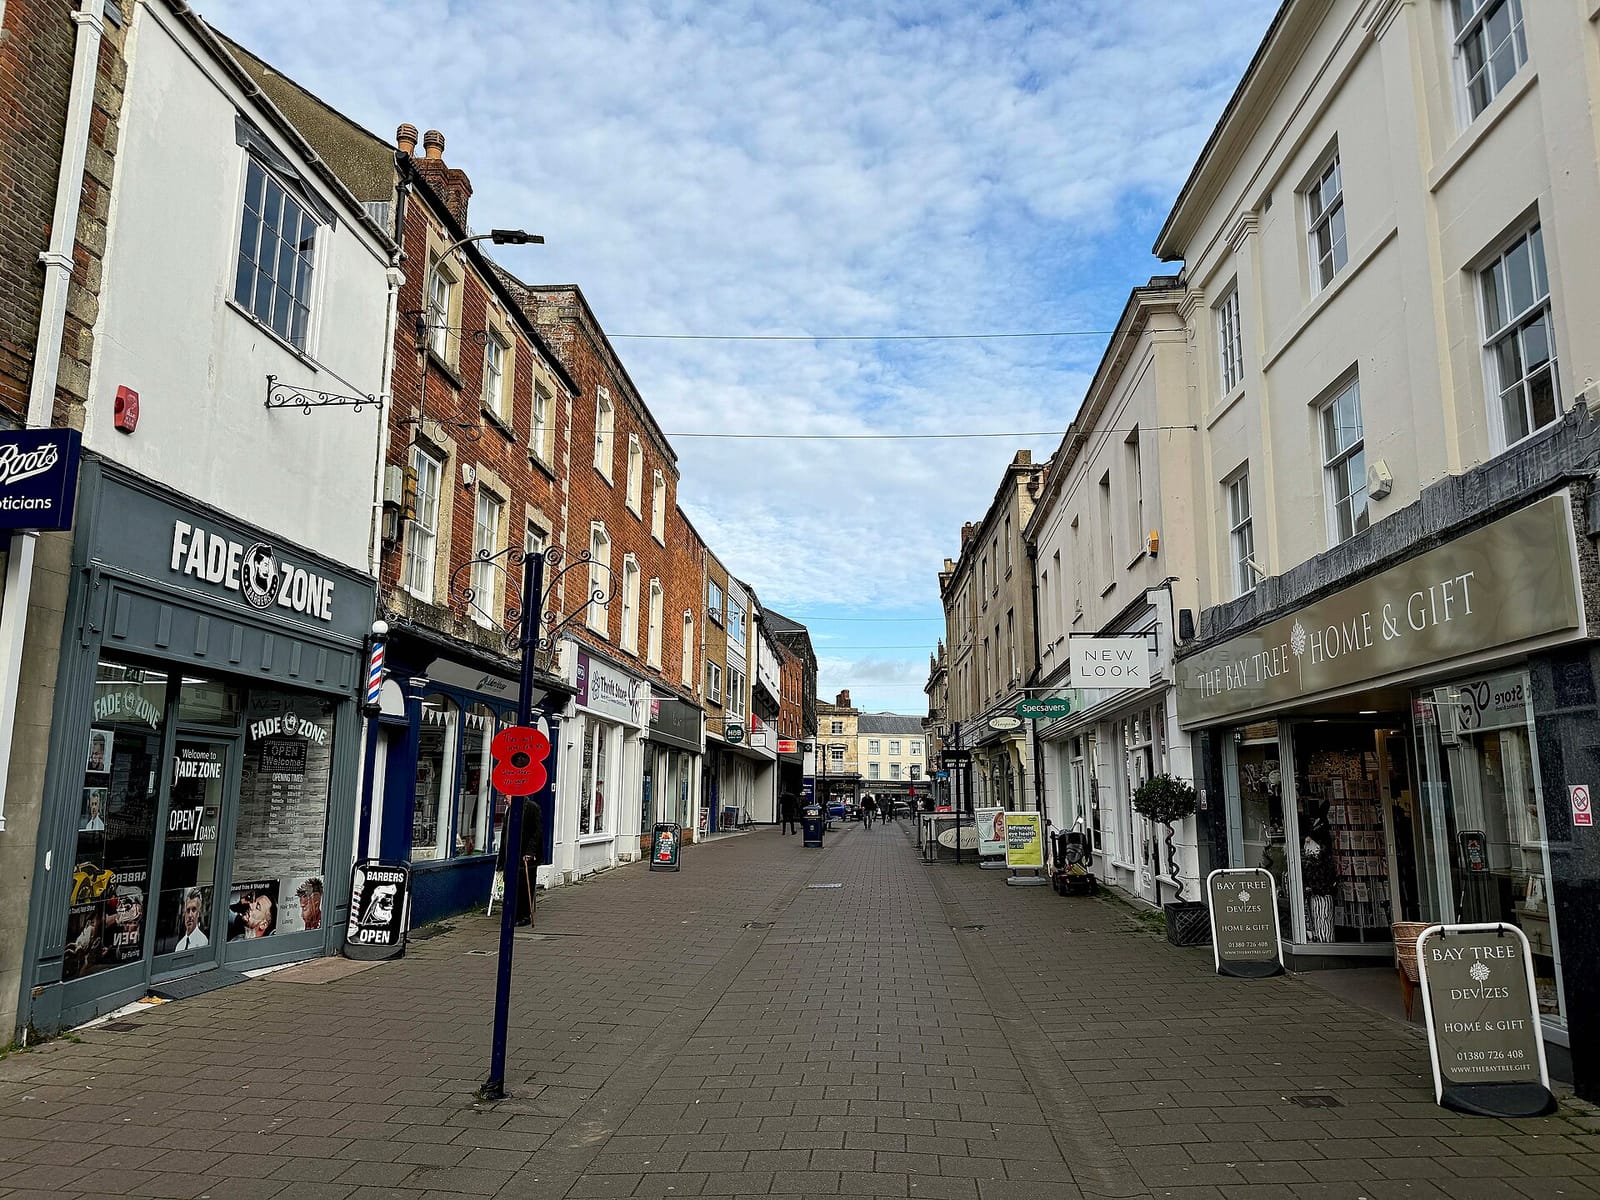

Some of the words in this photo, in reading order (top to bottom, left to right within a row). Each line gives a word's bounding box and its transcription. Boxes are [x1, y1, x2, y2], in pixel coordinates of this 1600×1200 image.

[0, 443, 58, 486] Boots
[171, 519, 244, 591] FADE
[277, 562, 335, 621] ZONE
[1198, 669, 1221, 699] THE
[1225, 658, 1248, 691] BAY
[1252, 643, 1290, 682] TREE
[1309, 611, 1374, 665] HOME
[1382, 603, 1401, 641] &
[1407, 570, 1475, 632] GIFT
[1085, 650, 1133, 661] NEW
[1081, 665, 1139, 677] LOOK
[600, 676, 615, 697] Thrift
[615, 683, 628, 701] Store
[94, 692, 122, 722] FADE
[135, 696, 160, 730] ZONE
[1022, 704, 1066, 713] Specsavers
[250, 716, 281, 741] FADE
[297, 718, 328, 746] ZONE
[182, 748, 210, 760] Welcome
[210, 751, 217, 760] to
[271, 745, 299, 757] OPEN
[198, 761, 222, 779] ZONE
[169, 809, 195, 831] OPEN
[193, 806, 204, 841] 7
[199, 825, 216, 841] DAYS
[180, 843, 187, 858] A
[186, 842, 204, 857] WEEK
[366, 871, 405, 883] BARBERS
[1216, 882, 1236, 890] BAY
[1239, 881, 1267, 890] TREE
[1226, 905, 1261, 913] DEVIZES
[1221, 924, 1243, 932] HOME
[360, 929, 390, 944] OPEN
[1432, 948, 1464, 961] BAY
[1469, 945, 1516, 960] TREE
[1451, 987, 1509, 1000] DEVIZES
[1444, 1022, 1482, 1033] HOME
[1484, 1021, 1494, 1031] &
[1496, 1020, 1525, 1031] GIFT
[1456, 1051, 1485, 1061] 01380
[1487, 1050, 1505, 1060] 726
[1507, 1049, 1524, 1060] 408
[1450, 1064, 1532, 1074] WWW.THEBAYTREE.GIFT
